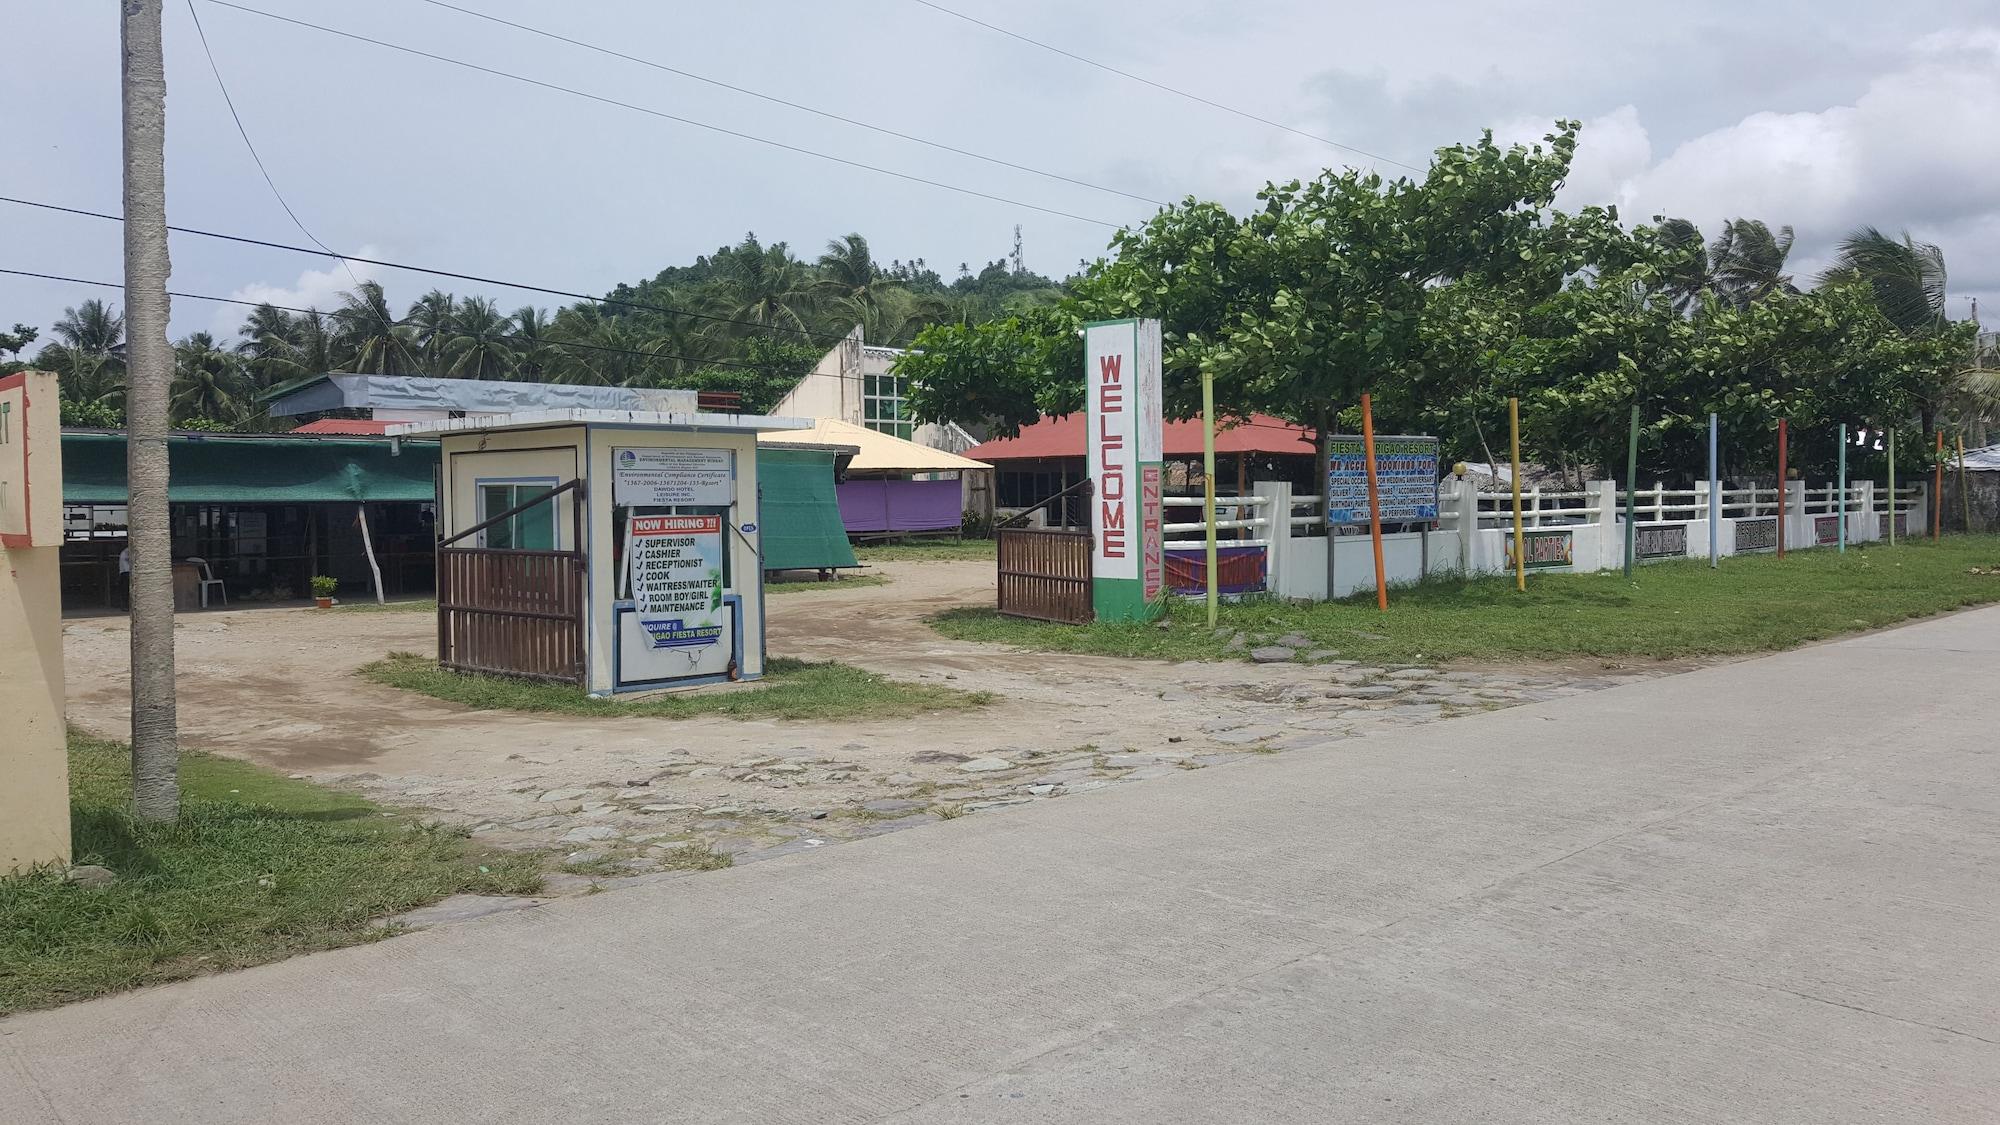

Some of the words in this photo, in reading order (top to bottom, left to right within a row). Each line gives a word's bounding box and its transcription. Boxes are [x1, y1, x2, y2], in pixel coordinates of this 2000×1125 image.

[1330, 443, 1360, 454] FIESTA
[1403, 443, 1433, 454] RESORT
[1099, 354, 1126, 558] WELCOME
[1377, 460, 1415, 470] BOOKINGS
[664, 471, 696, 479] Compliance
[697, 471, 726, 479] Certificate
[1331, 477, 1350, 485] SPECIAL
[1331, 500, 1353, 508] BIRTHDAY
[635, 519, 661, 530] NOW
[664, 518, 704, 530] HIRING
[1143, 469, 1160, 599] ENTRANCE
[645, 538, 696, 548] SUPERVISOR
[645, 549, 681, 559] CASHIER
[1534, 536, 1564, 562] PARTIES
[645, 559, 703, 570] RECEPTIONIST
[646, 571, 670, 581] COOK
[646, 580, 717, 591] WAITRESS/WAITER
[649, 593, 672, 602] ROOM
[674, 591, 709, 601] BOY/GIRL
[650, 602, 705, 613] MAINTENANCE
[672, 630, 696, 639] FIESTA
[696, 628, 721, 638] RESORT
